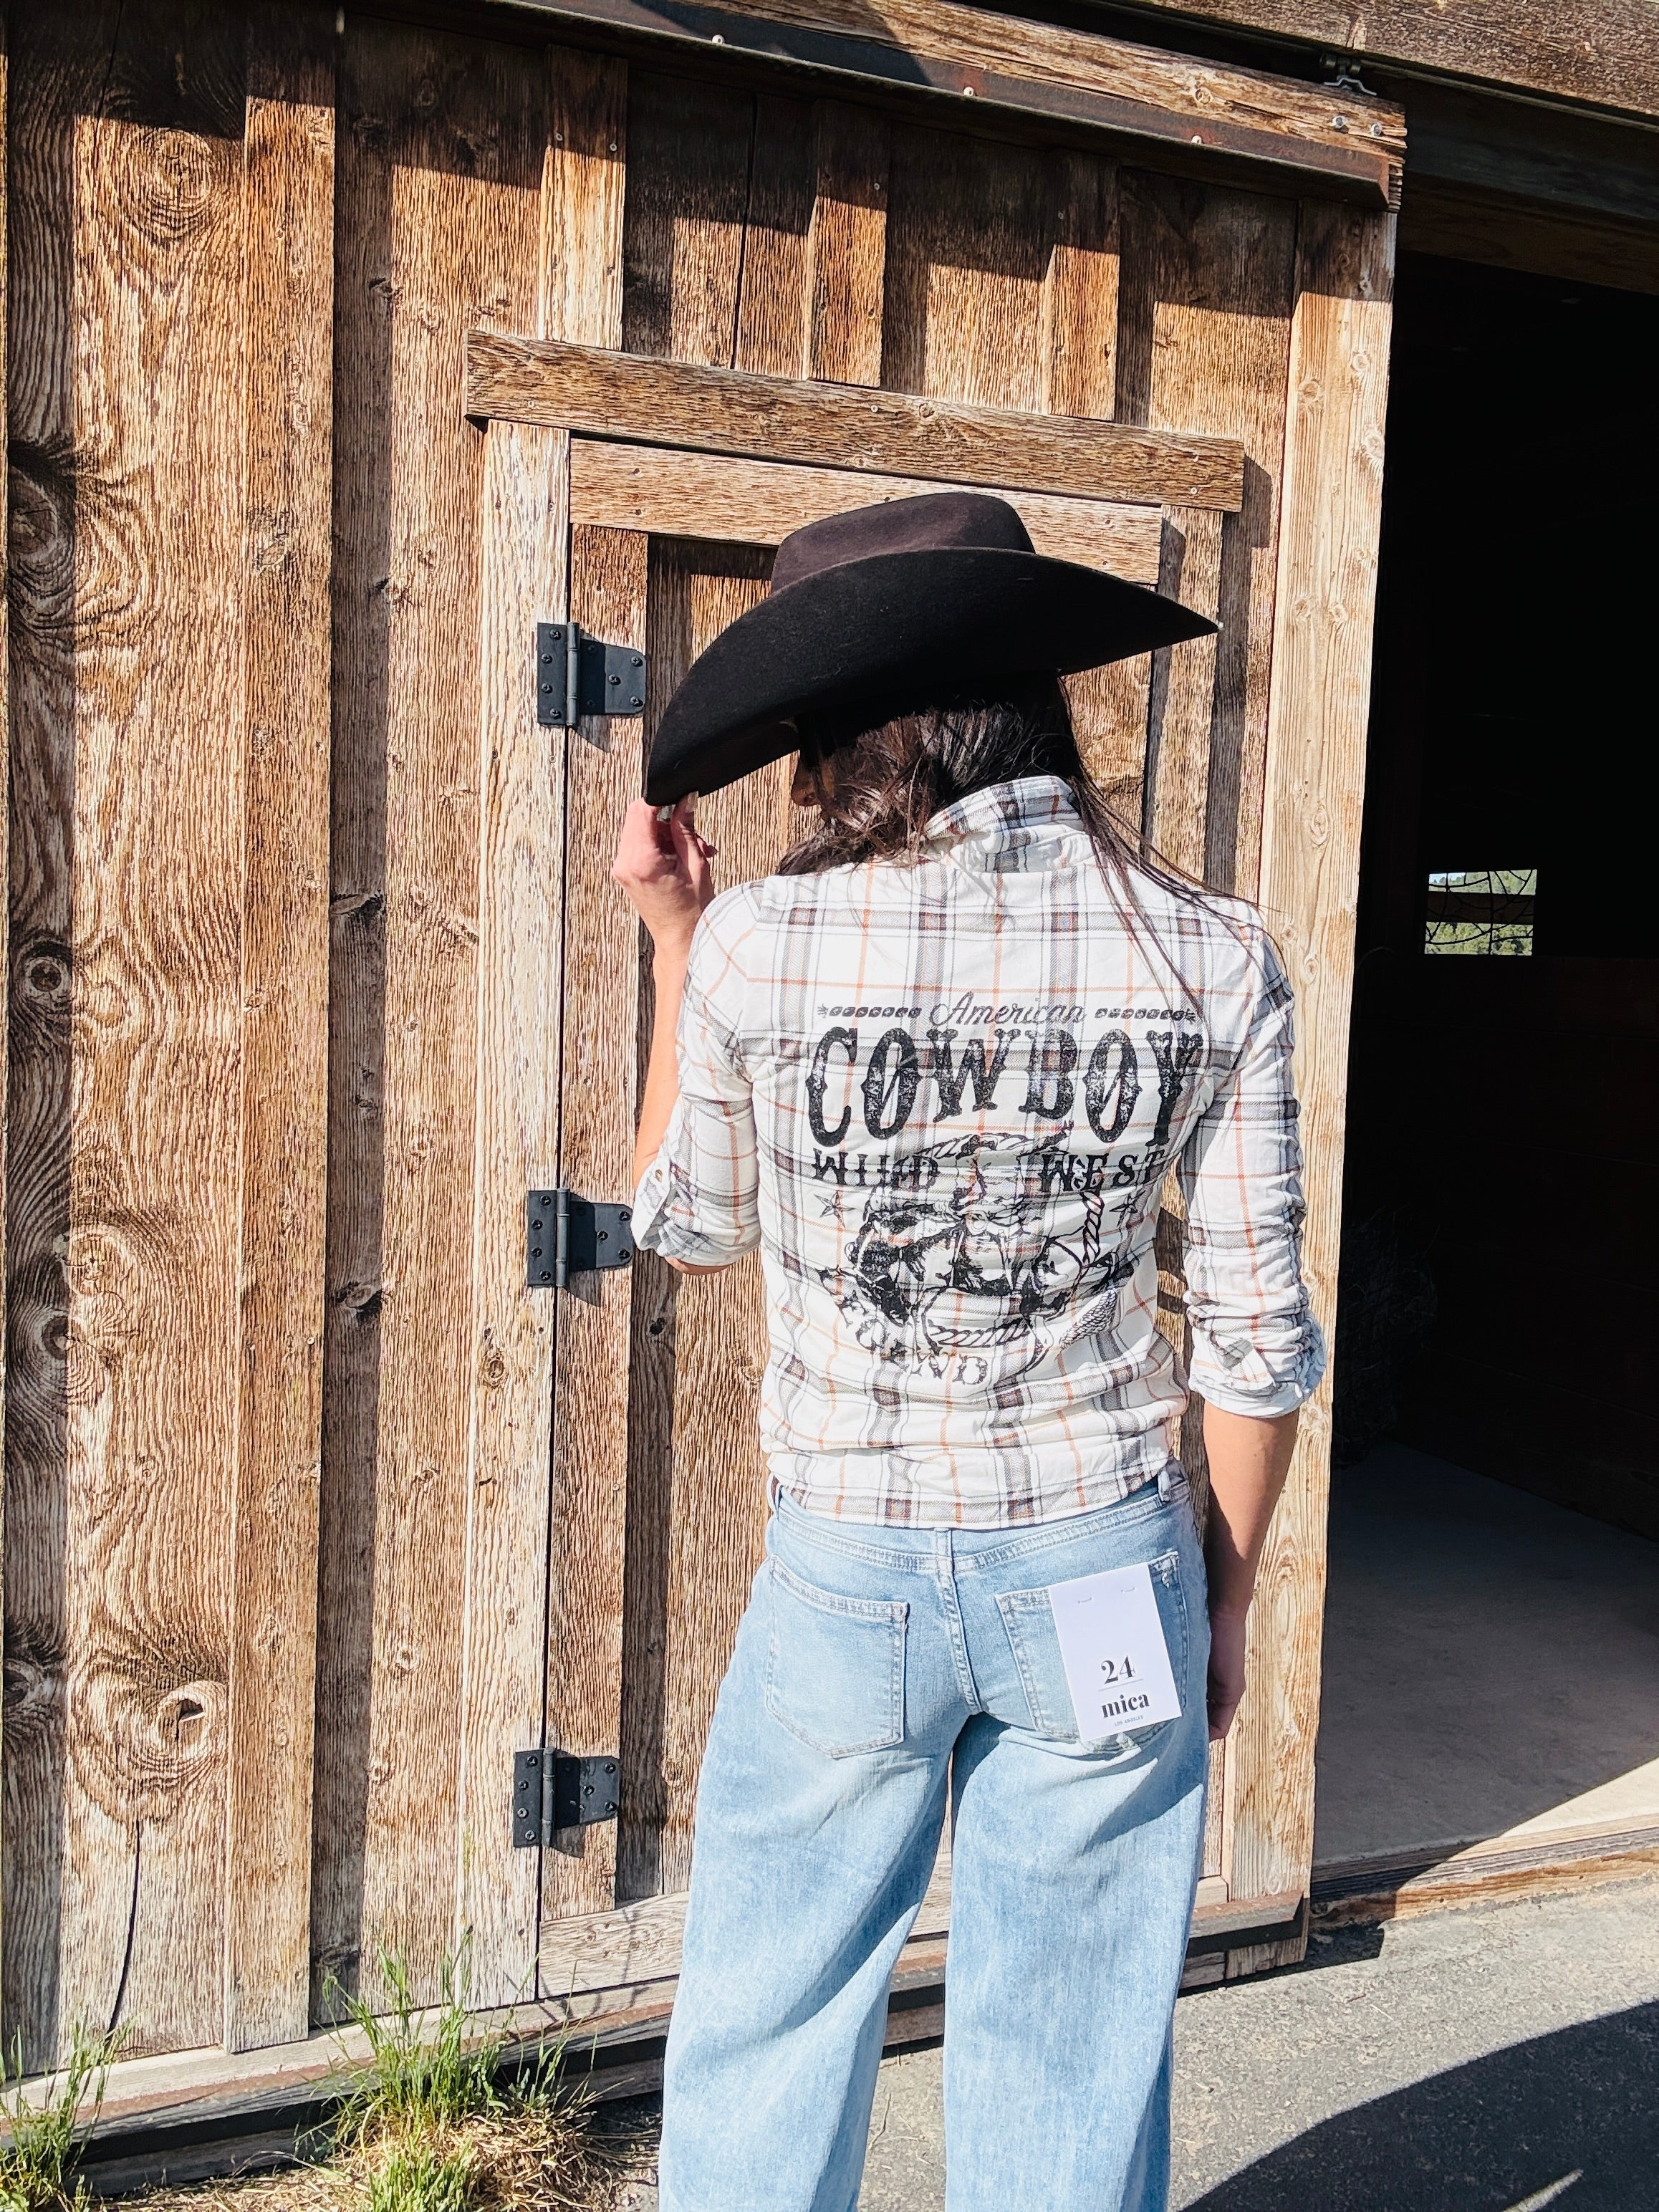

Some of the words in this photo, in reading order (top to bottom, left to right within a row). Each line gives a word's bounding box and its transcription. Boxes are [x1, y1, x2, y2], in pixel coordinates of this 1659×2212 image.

[929, 991, 1086, 1026] American
[805, 1026, 1203, 1147] COWBOY
[811, 1148, 941, 1191] WILD
[1038, 1149, 1165, 1197] WEST
[1100, 1655, 1135, 1685] 24
[1101, 1694, 1150, 1718] mica
[1124, 1715, 1144, 1723] ANGELES
